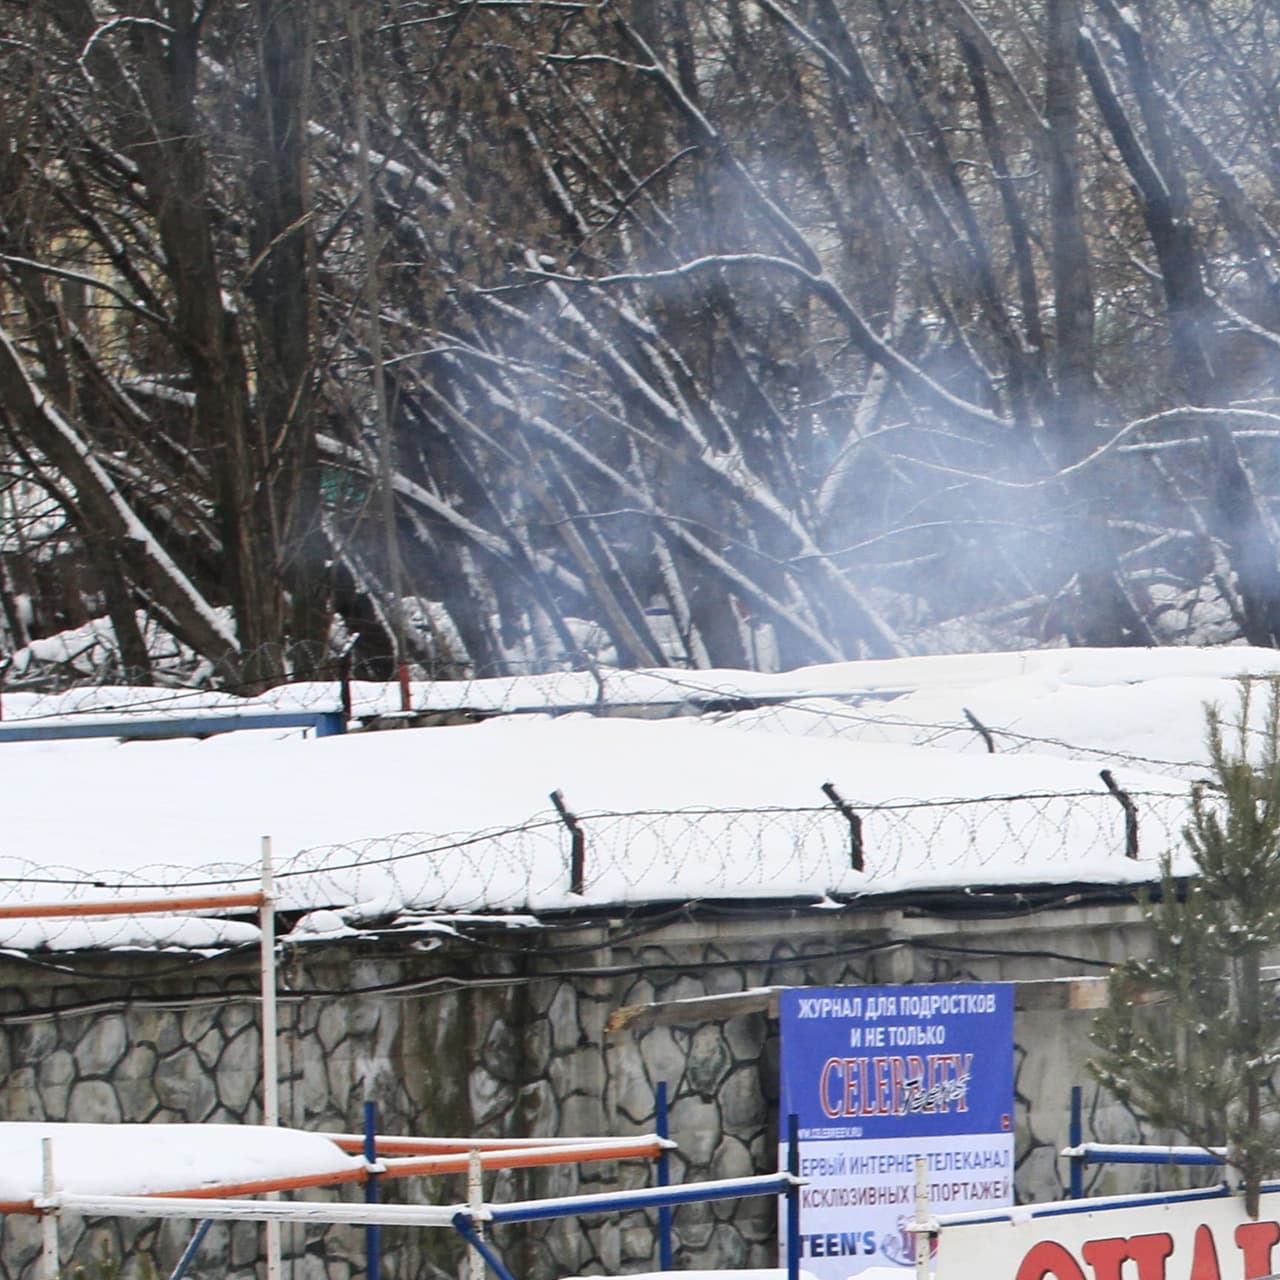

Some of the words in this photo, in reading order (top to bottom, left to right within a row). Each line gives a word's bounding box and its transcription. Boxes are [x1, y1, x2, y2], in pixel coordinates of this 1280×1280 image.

[798, 998, 861, 1018] ЖУРНАЛ
[865, 997, 897, 1020] ДЛЯ
[900, 994, 996, 1019] ПОДРОСТКОВ
[850, 1028, 861, 1048] И
[865, 1027, 885, 1047] НЕ
[888, 1025, 945, 1046] ТОЛЬКО
[819, 1053, 973, 1118] CELEBRITY
[801, 1152, 845, 1177] ЕРВЫЙ
[927, 1149, 1009, 1171] ТЕЛЕКАНАЛ
[802, 1185, 910, 1209] КСКЛЮЗИВНЫХ
[913, 1176, 1010, 1202] ПОРТАЖЕЙ
